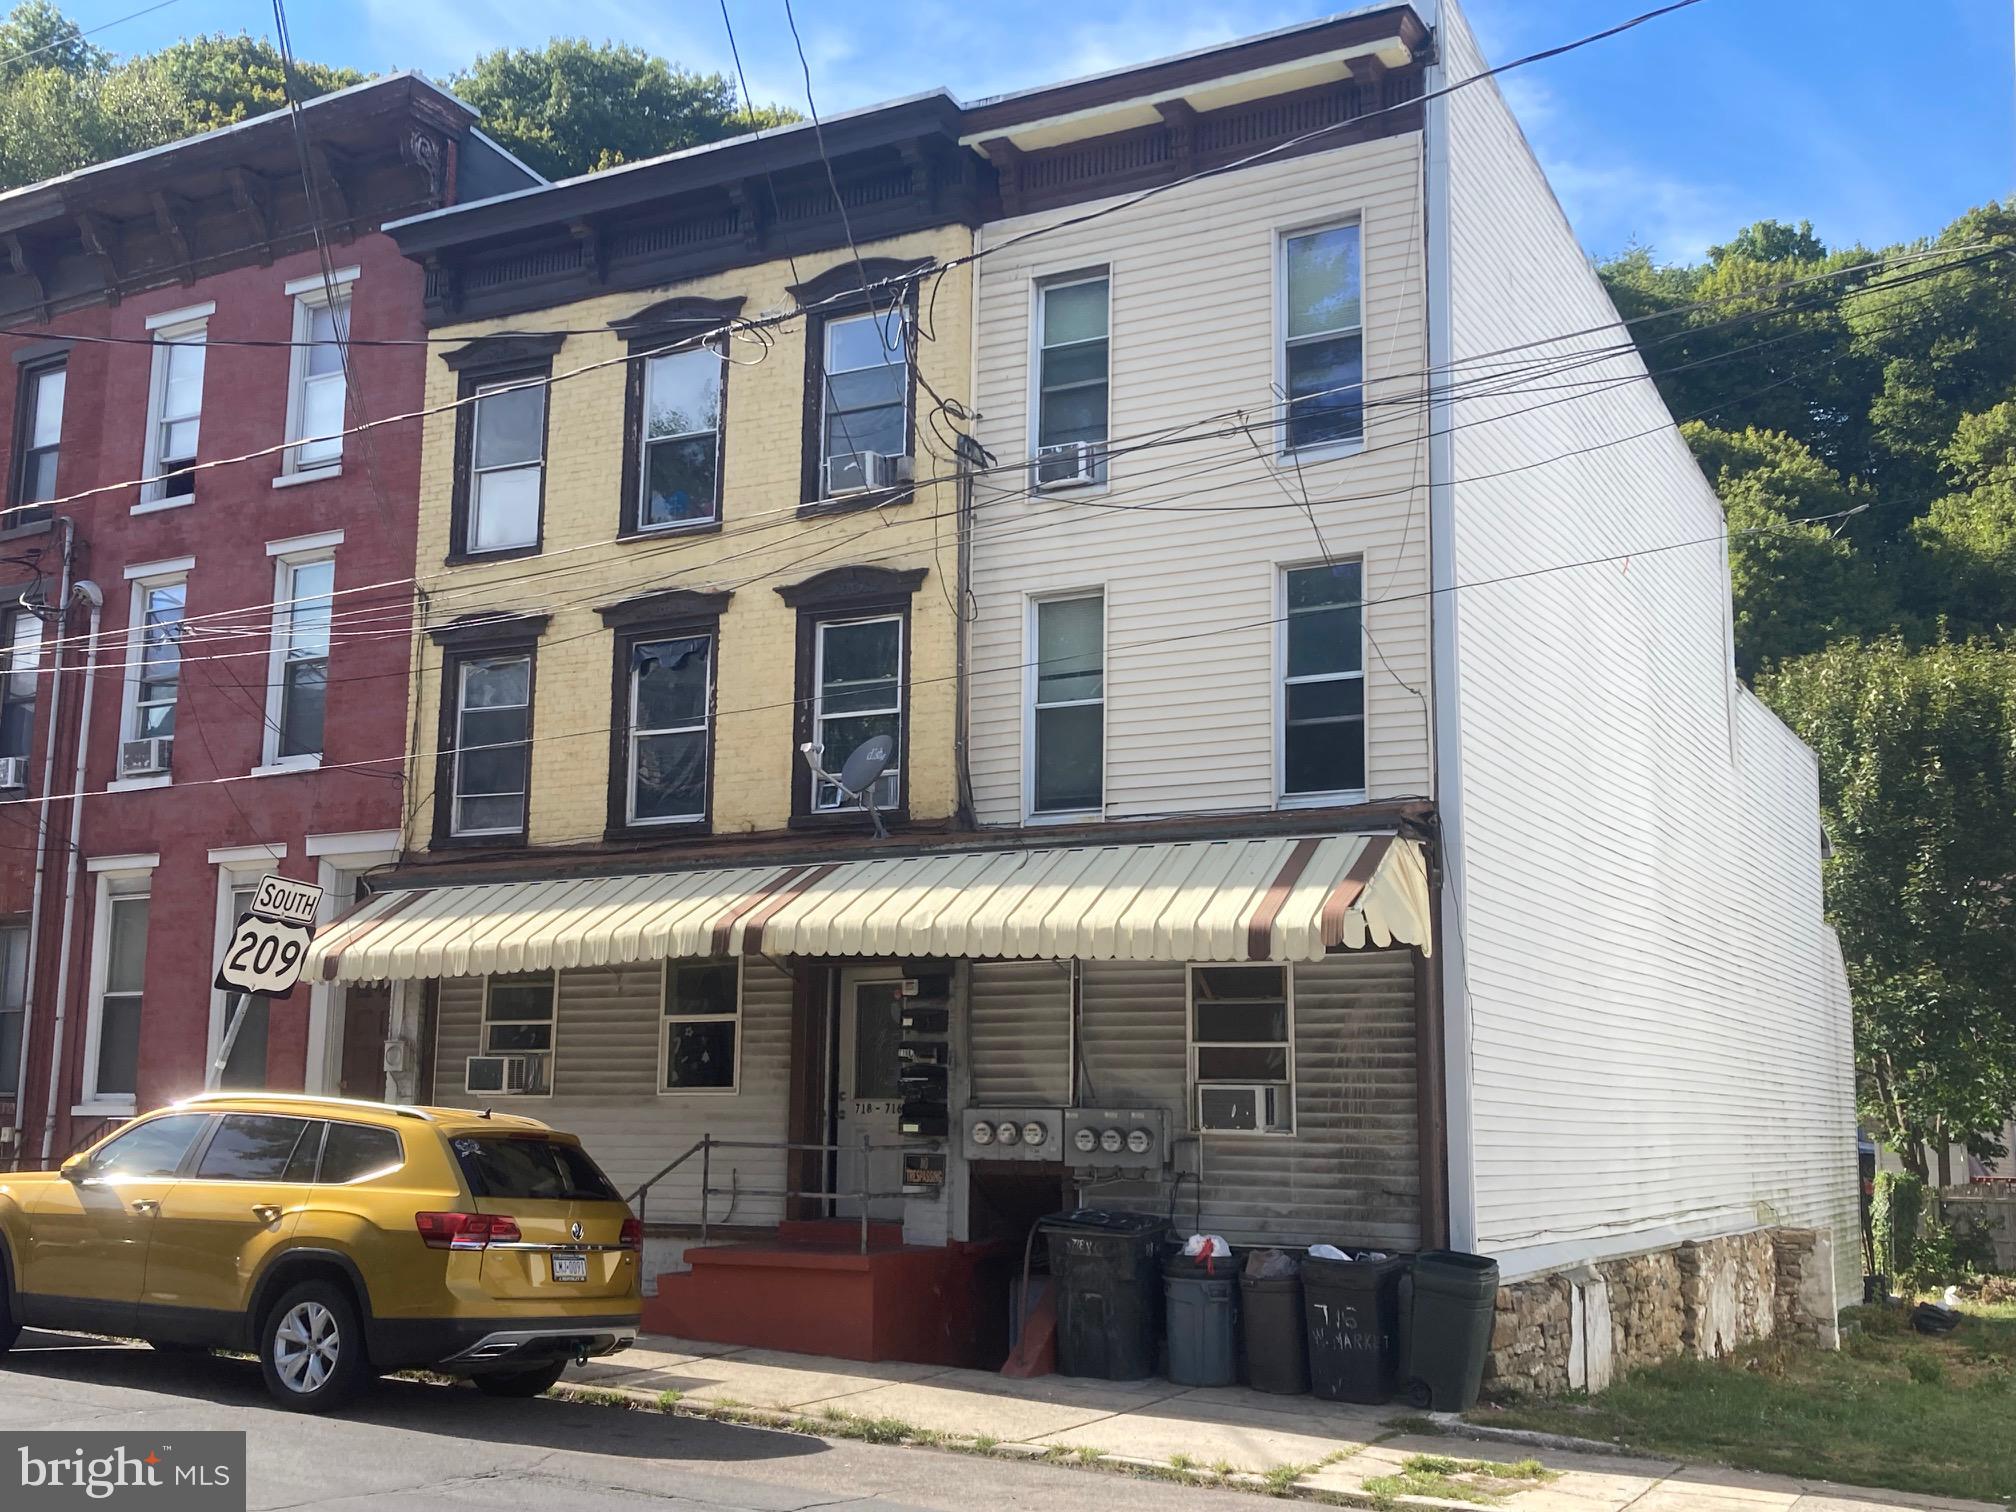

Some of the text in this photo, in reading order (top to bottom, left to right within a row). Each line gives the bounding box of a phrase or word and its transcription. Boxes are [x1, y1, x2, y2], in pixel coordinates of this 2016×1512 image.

[260, 883, 317, 916] SOUTH
[229, 931, 301, 977] 209
[855, 1103, 873, 1114] 718
